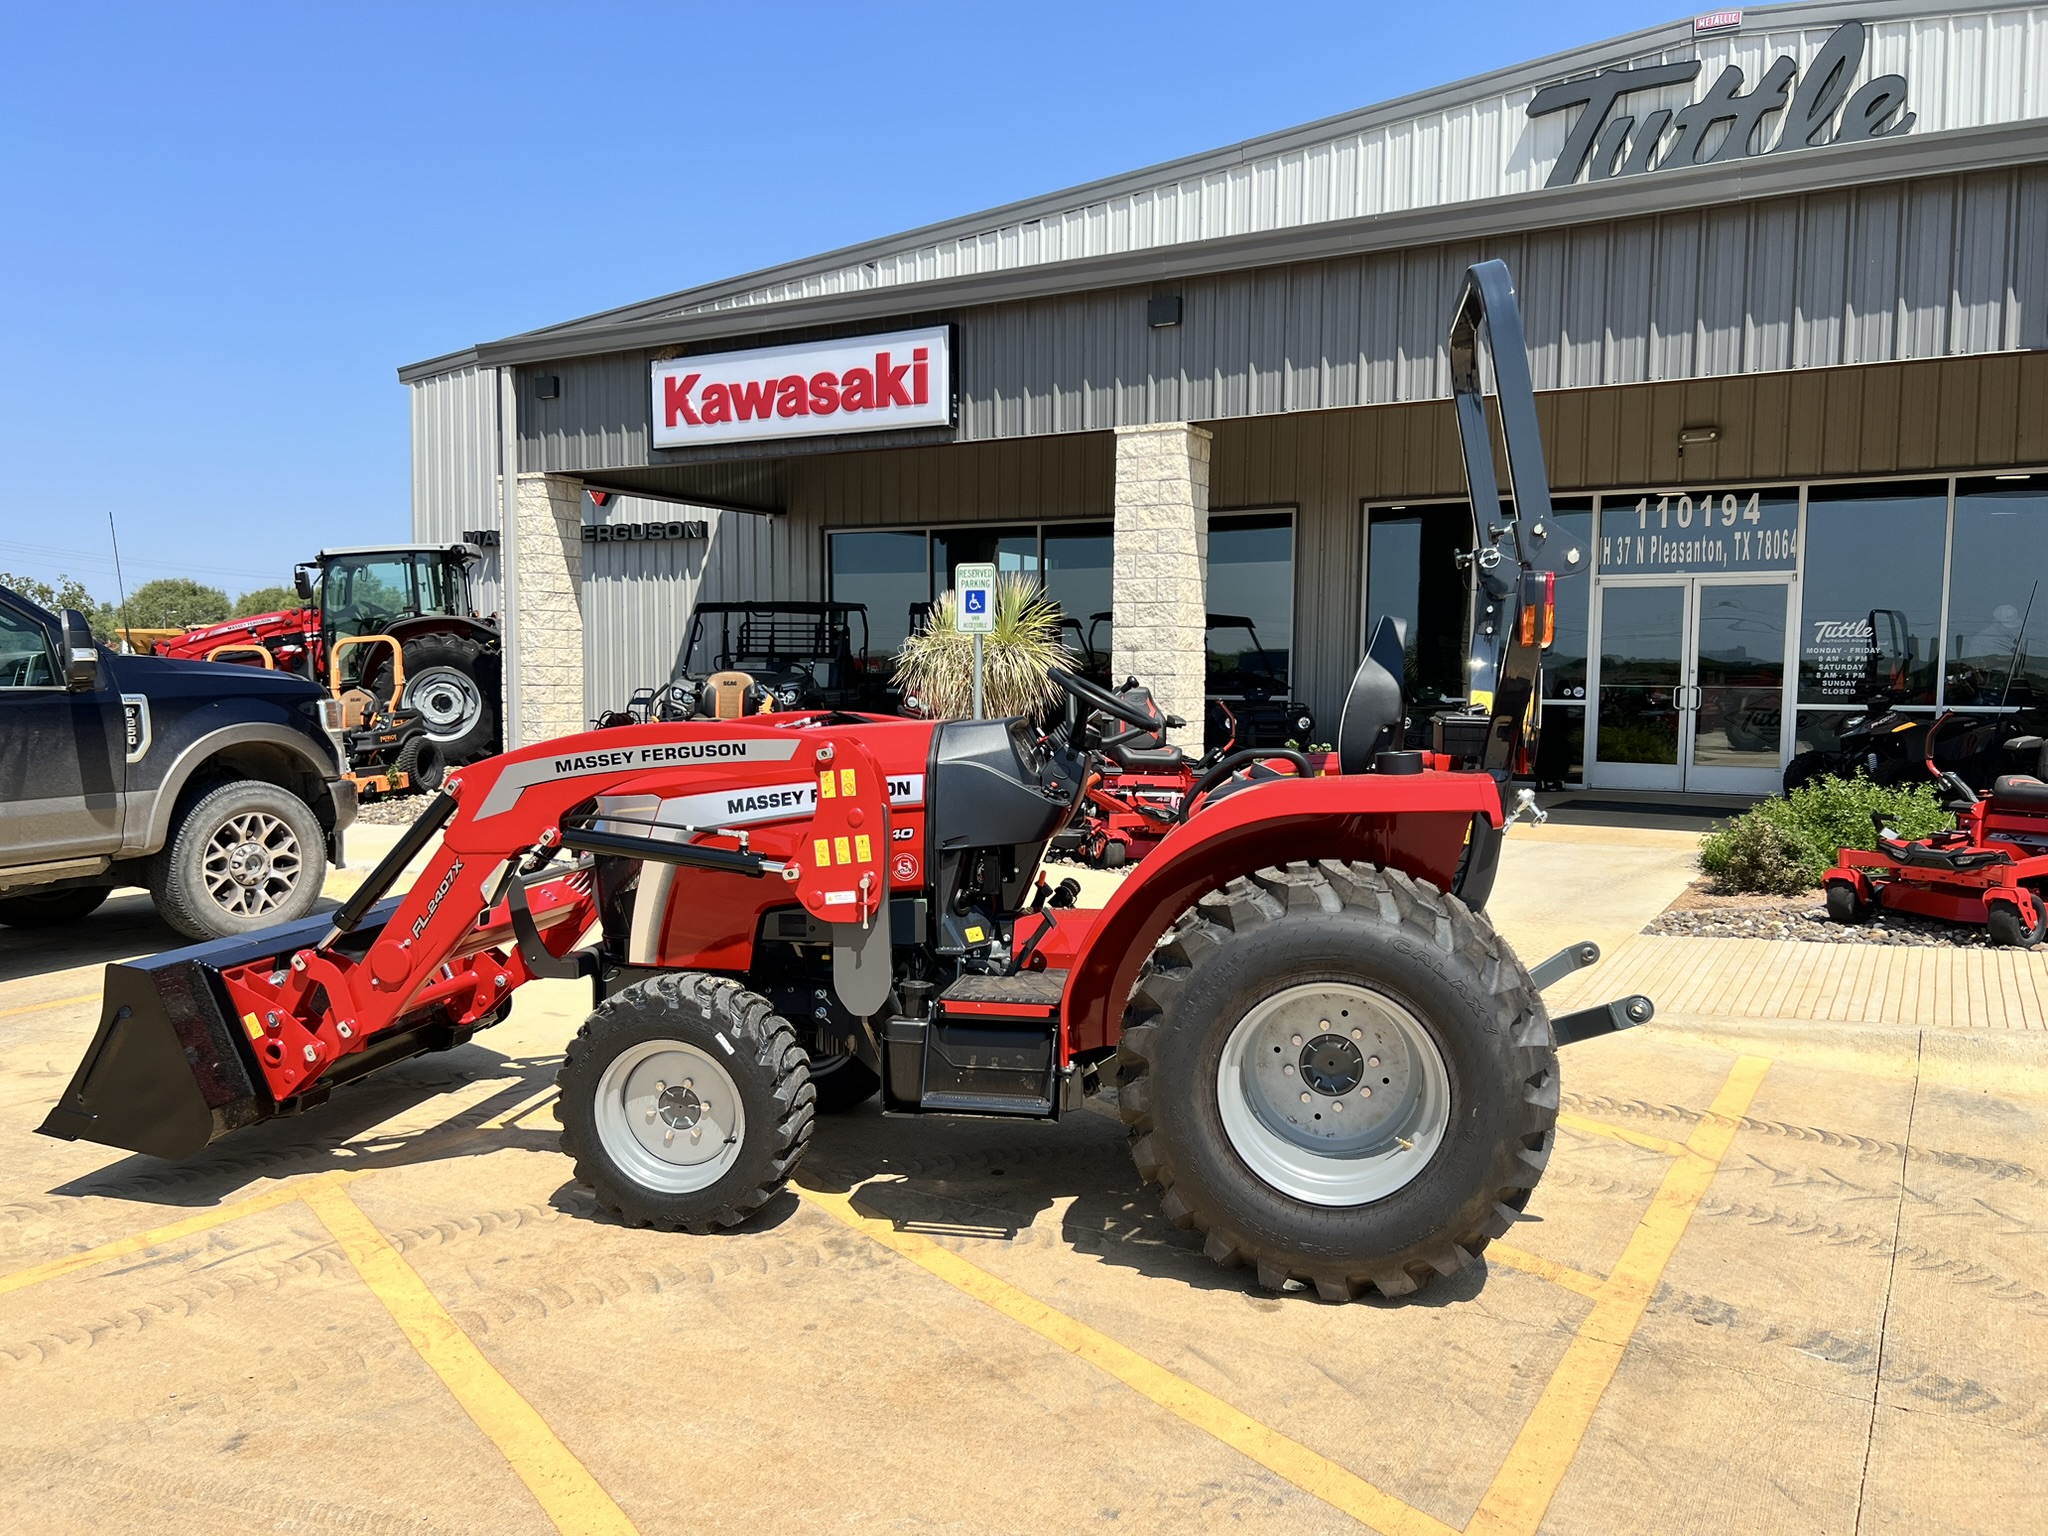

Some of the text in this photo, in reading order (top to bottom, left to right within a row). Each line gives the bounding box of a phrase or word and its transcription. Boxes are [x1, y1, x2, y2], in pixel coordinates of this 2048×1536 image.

[1526, 21, 1917, 188] Tuttle
[664, 347, 929, 428] Kawasaki
[1635, 492, 1761, 529] 110194
[581, 520, 708, 543] ERGUSON
[1616, 536, 1631, 566] 37
[1636, 535, 1645, 565] N
[1650, 534, 1727, 568] Pleasanton,
[1734, 531, 1750, 561] TX
[1757, 528, 1797, 561] 78064
[958, 568, 993, 578] RESERVED
[961, 580, 991, 589] PARKING
[1814, 619, 1874, 643] Tuttle
[555, 743, 747, 773] MASSEY FERGUSON
[727, 789, 805, 814] MASSEY
[892, 827, 914, 840] 40
[411, 854, 465, 940] FL.2407X
[1392, 939, 1499, 1035] GALAXY
